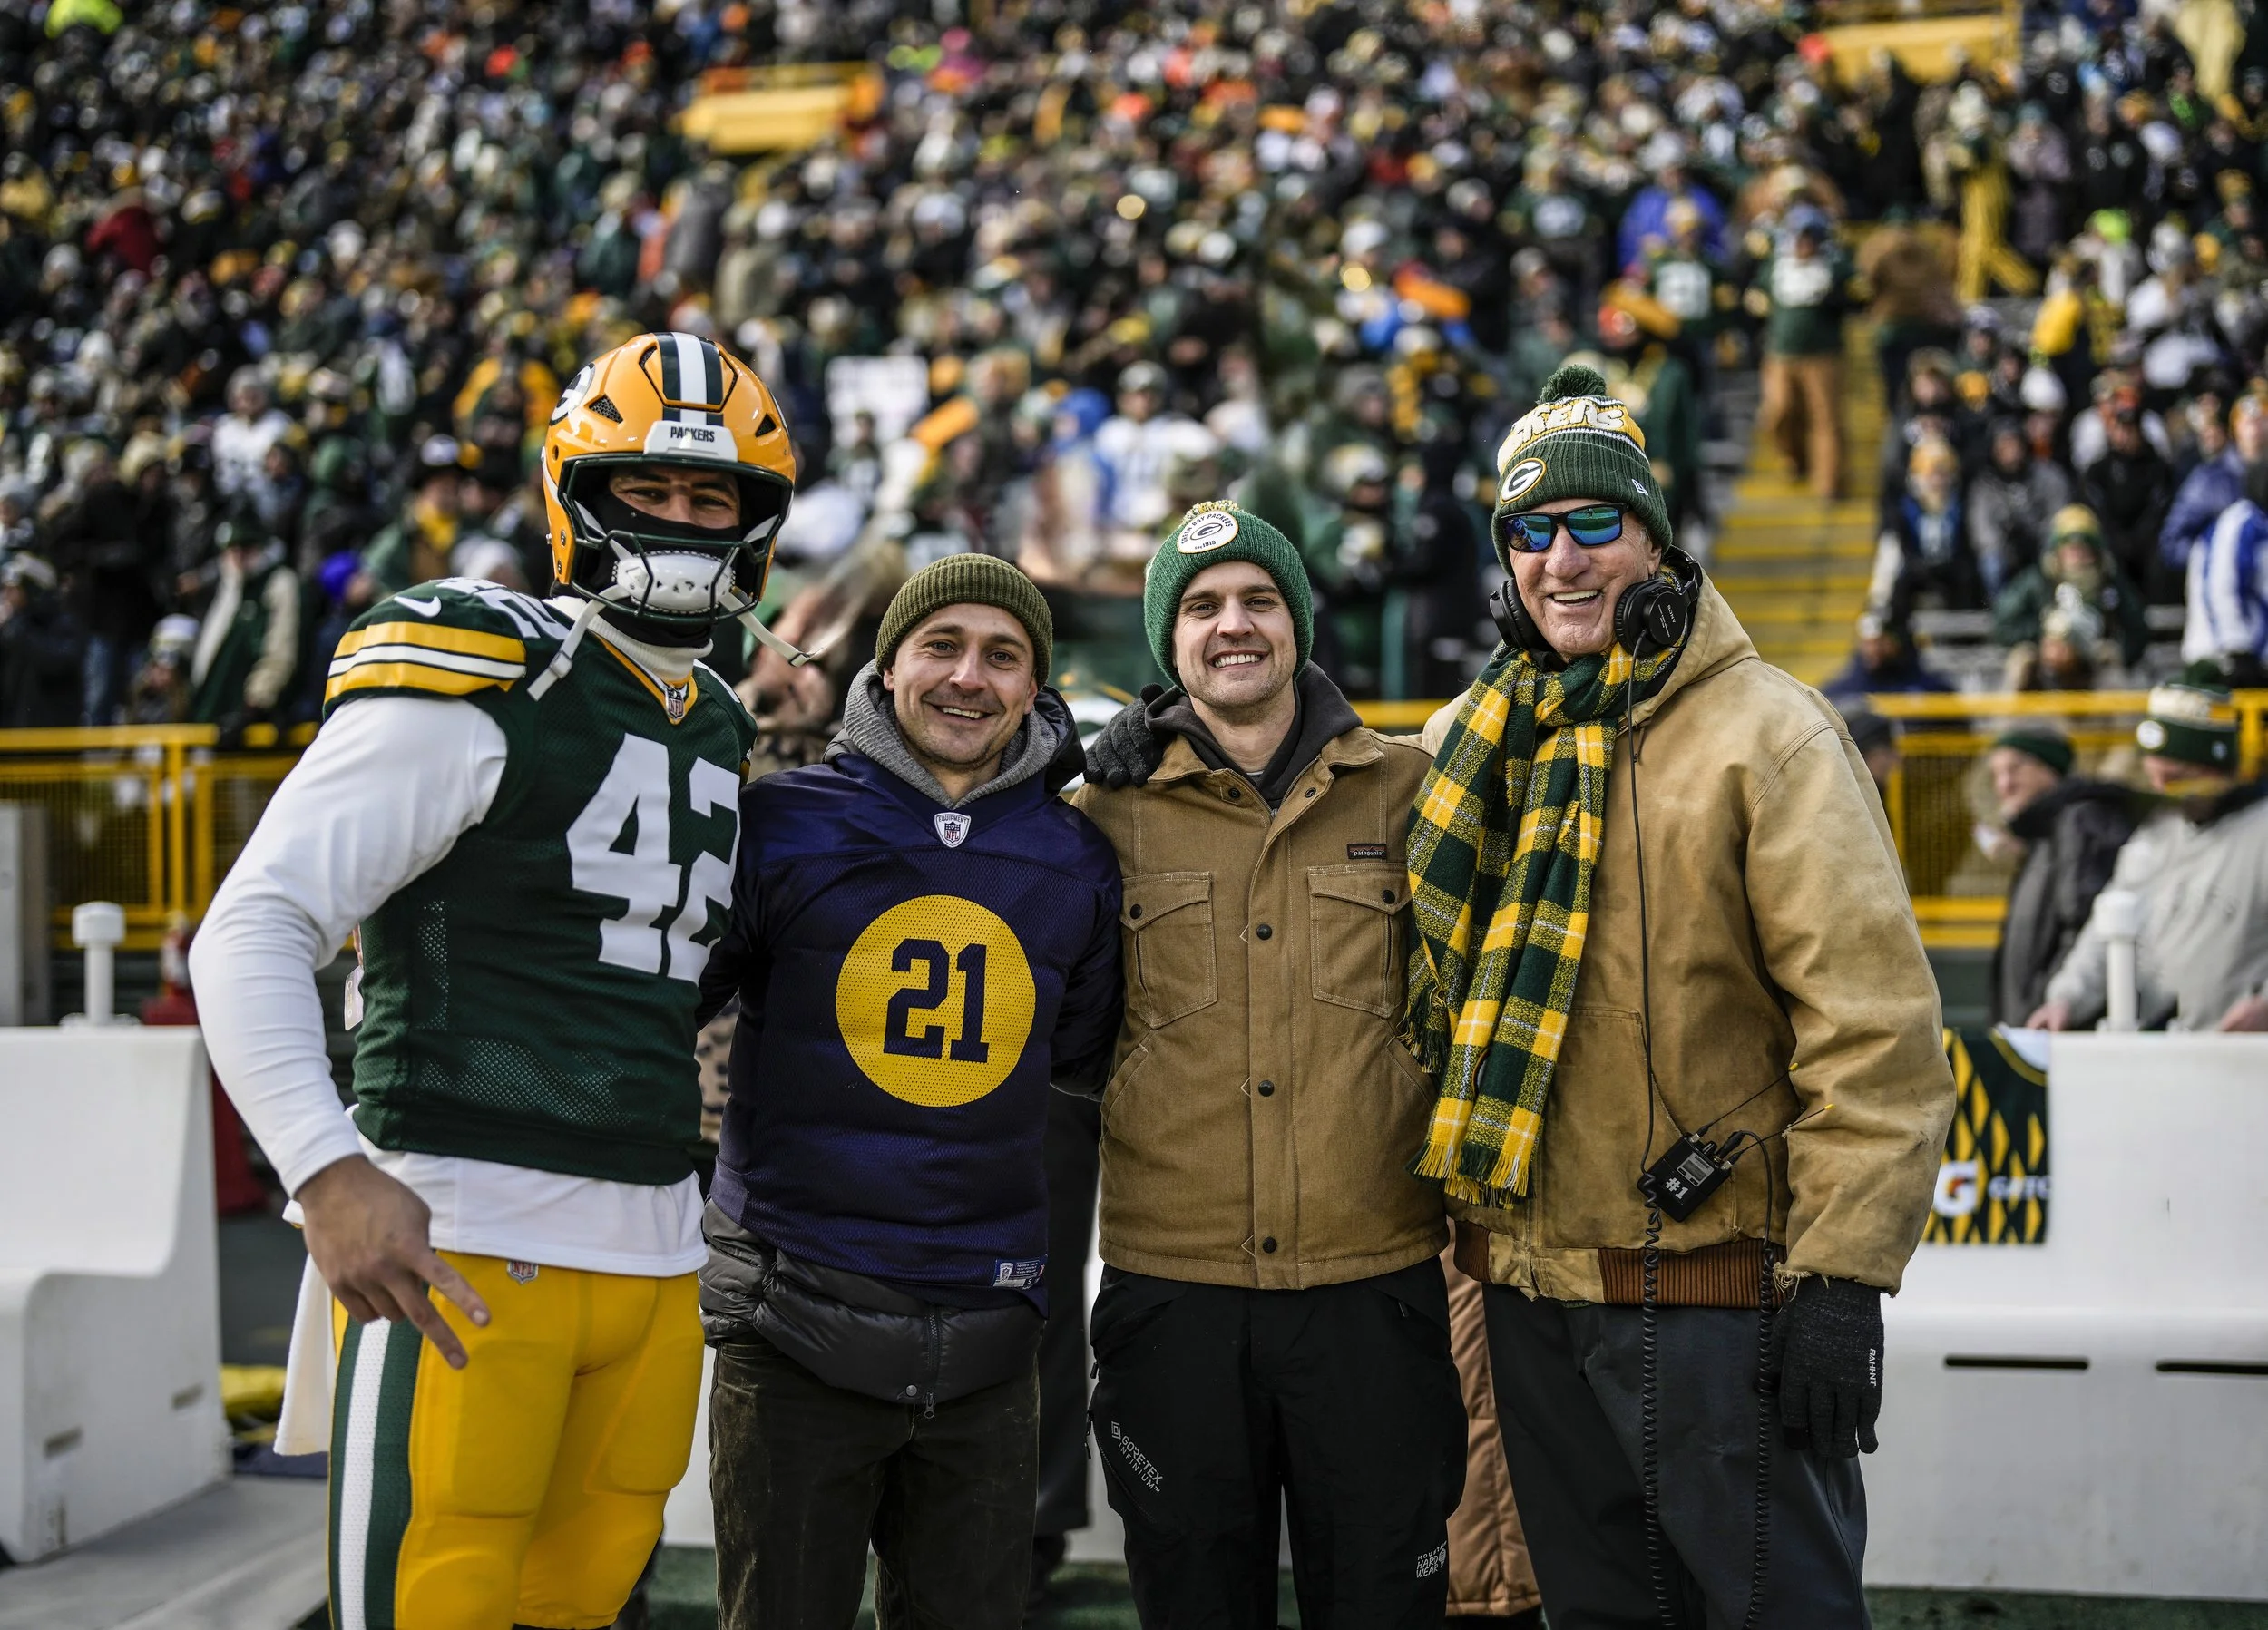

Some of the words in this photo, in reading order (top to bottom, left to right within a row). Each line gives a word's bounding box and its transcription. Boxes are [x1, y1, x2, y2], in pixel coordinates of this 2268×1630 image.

[1501, 459, 1544, 503] G
[1192, 516, 1205, 526] BAY
[1207, 513, 1234, 528] PACKERS
[1667, 604, 1676, 623] SONY
[938, 815, 967, 824] EQUIPMENT
[946, 830, 960, 841] NFL
[566, 733, 742, 987] 42
[884, 938, 990, 1063] 21
[1665, 1177, 1688, 1199] #1
[1933, 1160, 1979, 1217] G
[1121, 1435, 1163, 1484] GORE-TEX
[1416, 1564, 1439, 1578] WEAR
[1417, 1556, 1438, 1569] HARD
